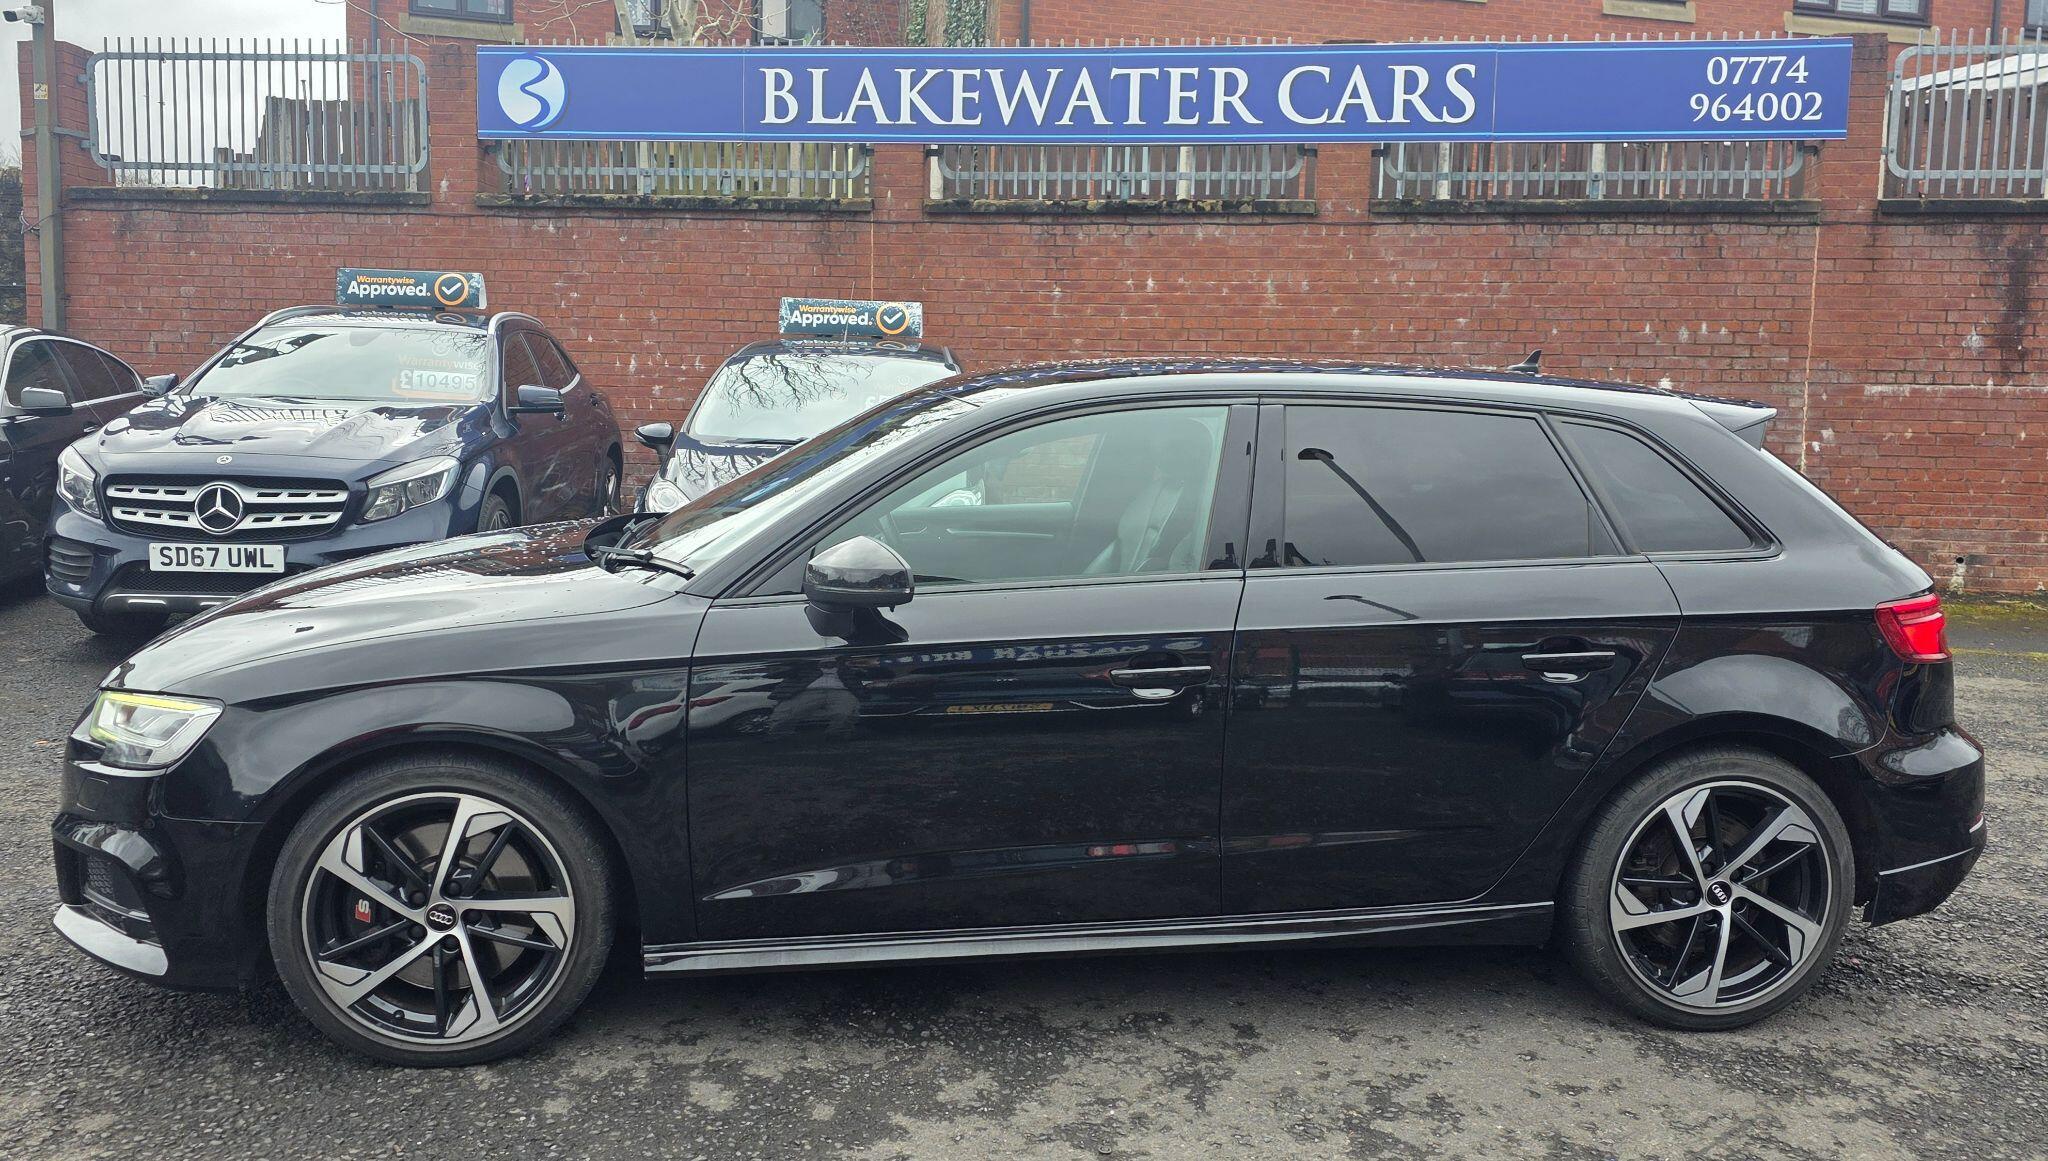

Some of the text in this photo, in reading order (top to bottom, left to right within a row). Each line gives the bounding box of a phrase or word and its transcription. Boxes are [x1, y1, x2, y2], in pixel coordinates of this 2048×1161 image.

[1705, 55, 1810, 86] 07774
[758, 63, 1478, 126] BLAKEWATER CARS
[1689, 91, 1824, 123] 964002
[347, 280, 431, 298] Approved.
[356, 274, 416, 285] Warrantywise
[790, 310, 873, 327] Approved.
[159, 546, 275, 568] SD67 UWL
